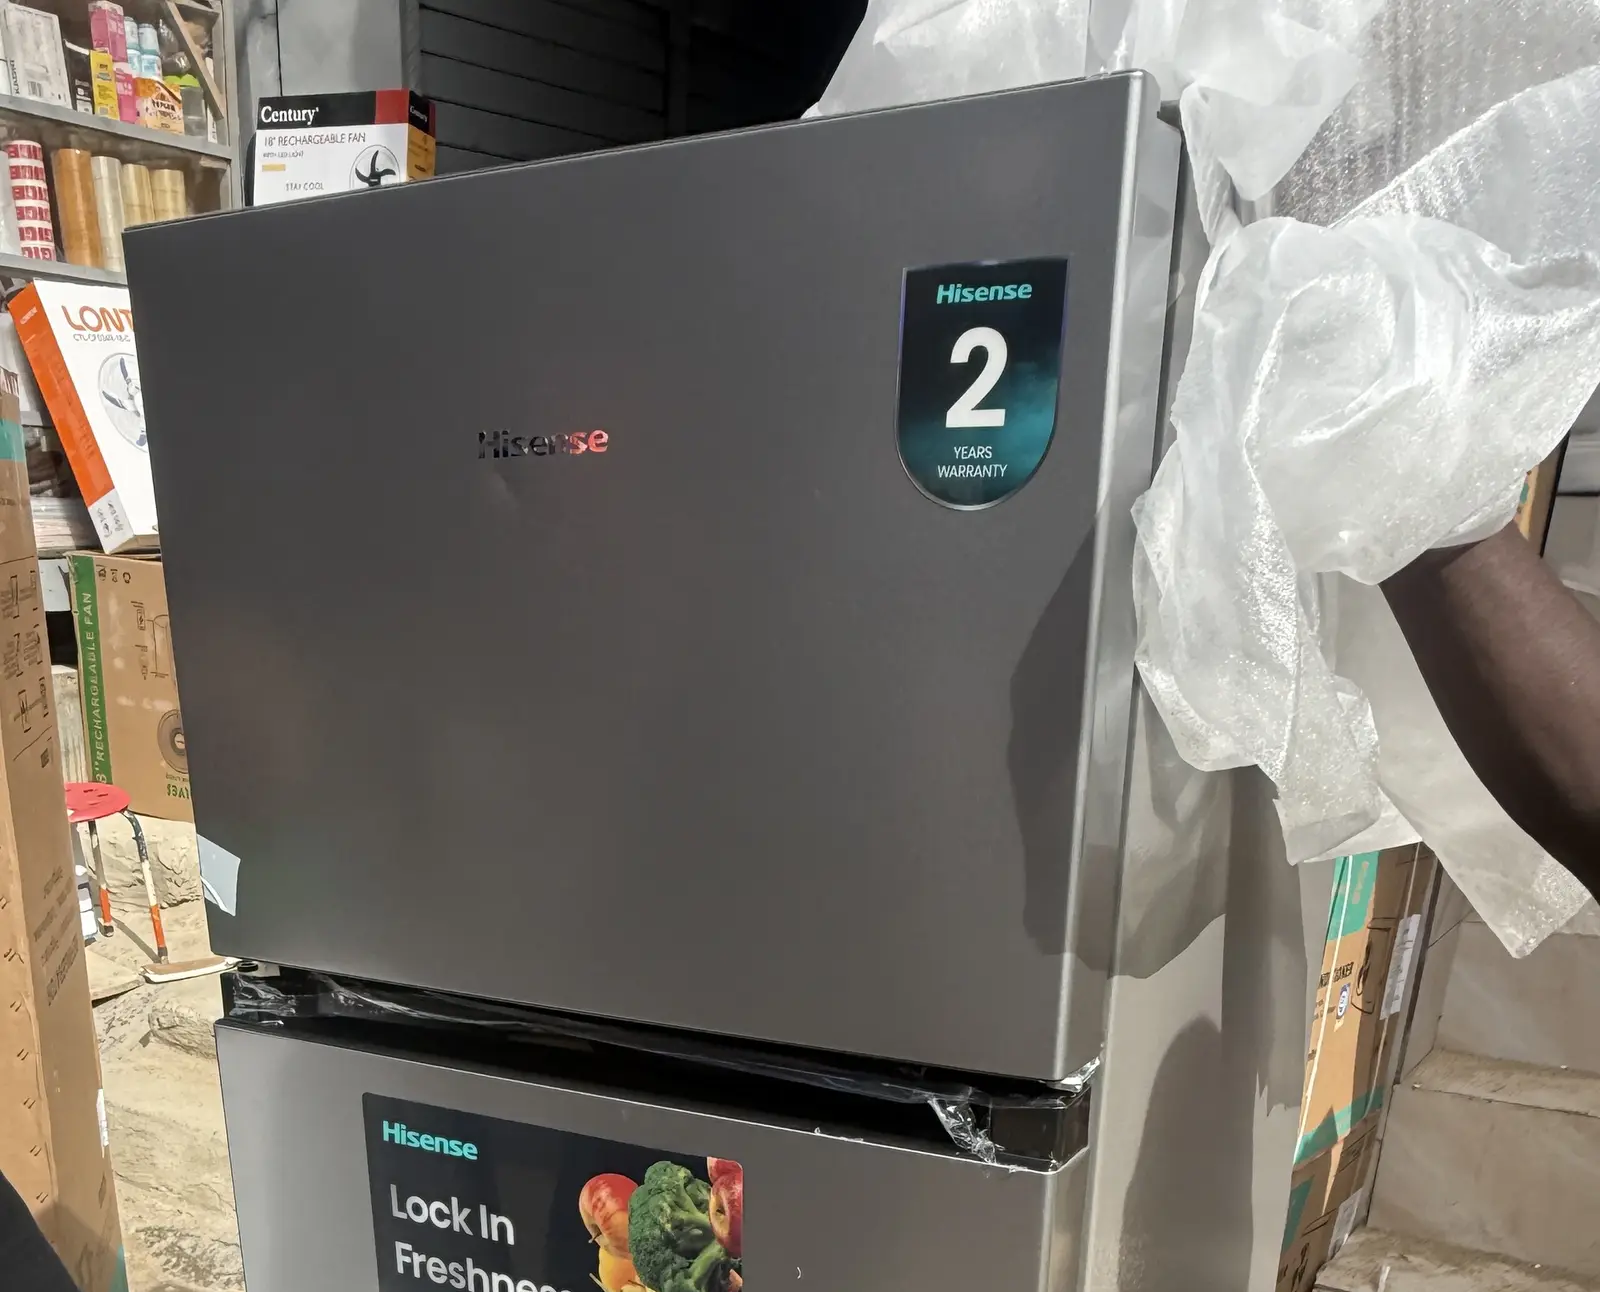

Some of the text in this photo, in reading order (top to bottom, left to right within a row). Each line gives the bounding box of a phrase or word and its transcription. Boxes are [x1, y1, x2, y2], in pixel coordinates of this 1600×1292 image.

[261, 106, 316, 125] Century
[278, 133, 345, 147] RECHARGEABLE
[348, 132, 366, 144] FAN
[304, 182, 324, 191] COOL
[936, 283, 1032, 304] Hisense
[946, 326, 1008, 428] 2
[478, 429, 609, 459] Hisense
[954, 446, 993, 459] YEARS
[938, 464, 1008, 478] WARRANTY
[83, 592, 94, 625] FAN
[383, 1120, 478, 1160] Hisense
[390, 1184, 514, 1245] Lock In
